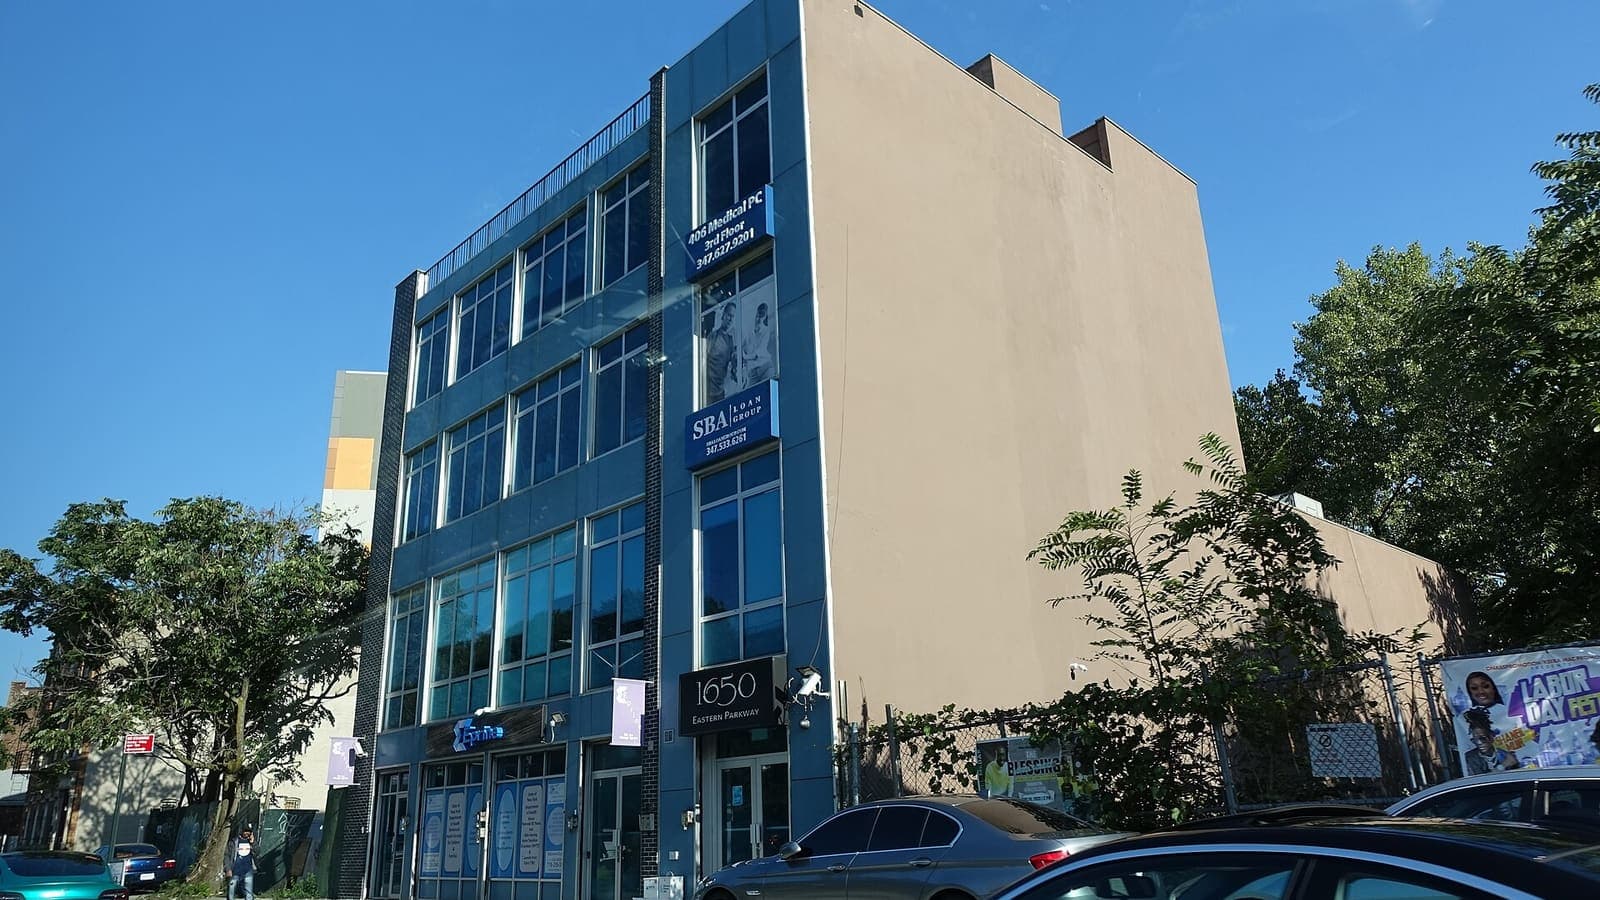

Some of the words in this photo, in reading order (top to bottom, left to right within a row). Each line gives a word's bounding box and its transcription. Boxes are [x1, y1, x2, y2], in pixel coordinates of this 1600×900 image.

[688, 226, 707, 245] 406
[708, 200, 747, 234] Medical
[748, 190, 763, 210] PC
[696, 227, 755, 270] 347.627.9201
[704, 236, 720, 252] 3rd
[720, 221, 745, 242] Floor
[732, 406, 762, 424] GROUP
[733, 395, 761, 413] LOAN
[693, 410, 729, 441] SBA
[696, 672, 756, 707] 1650
[1520, 668, 1591, 702] LABOR
[1526, 697, 1566, 727] DAY
